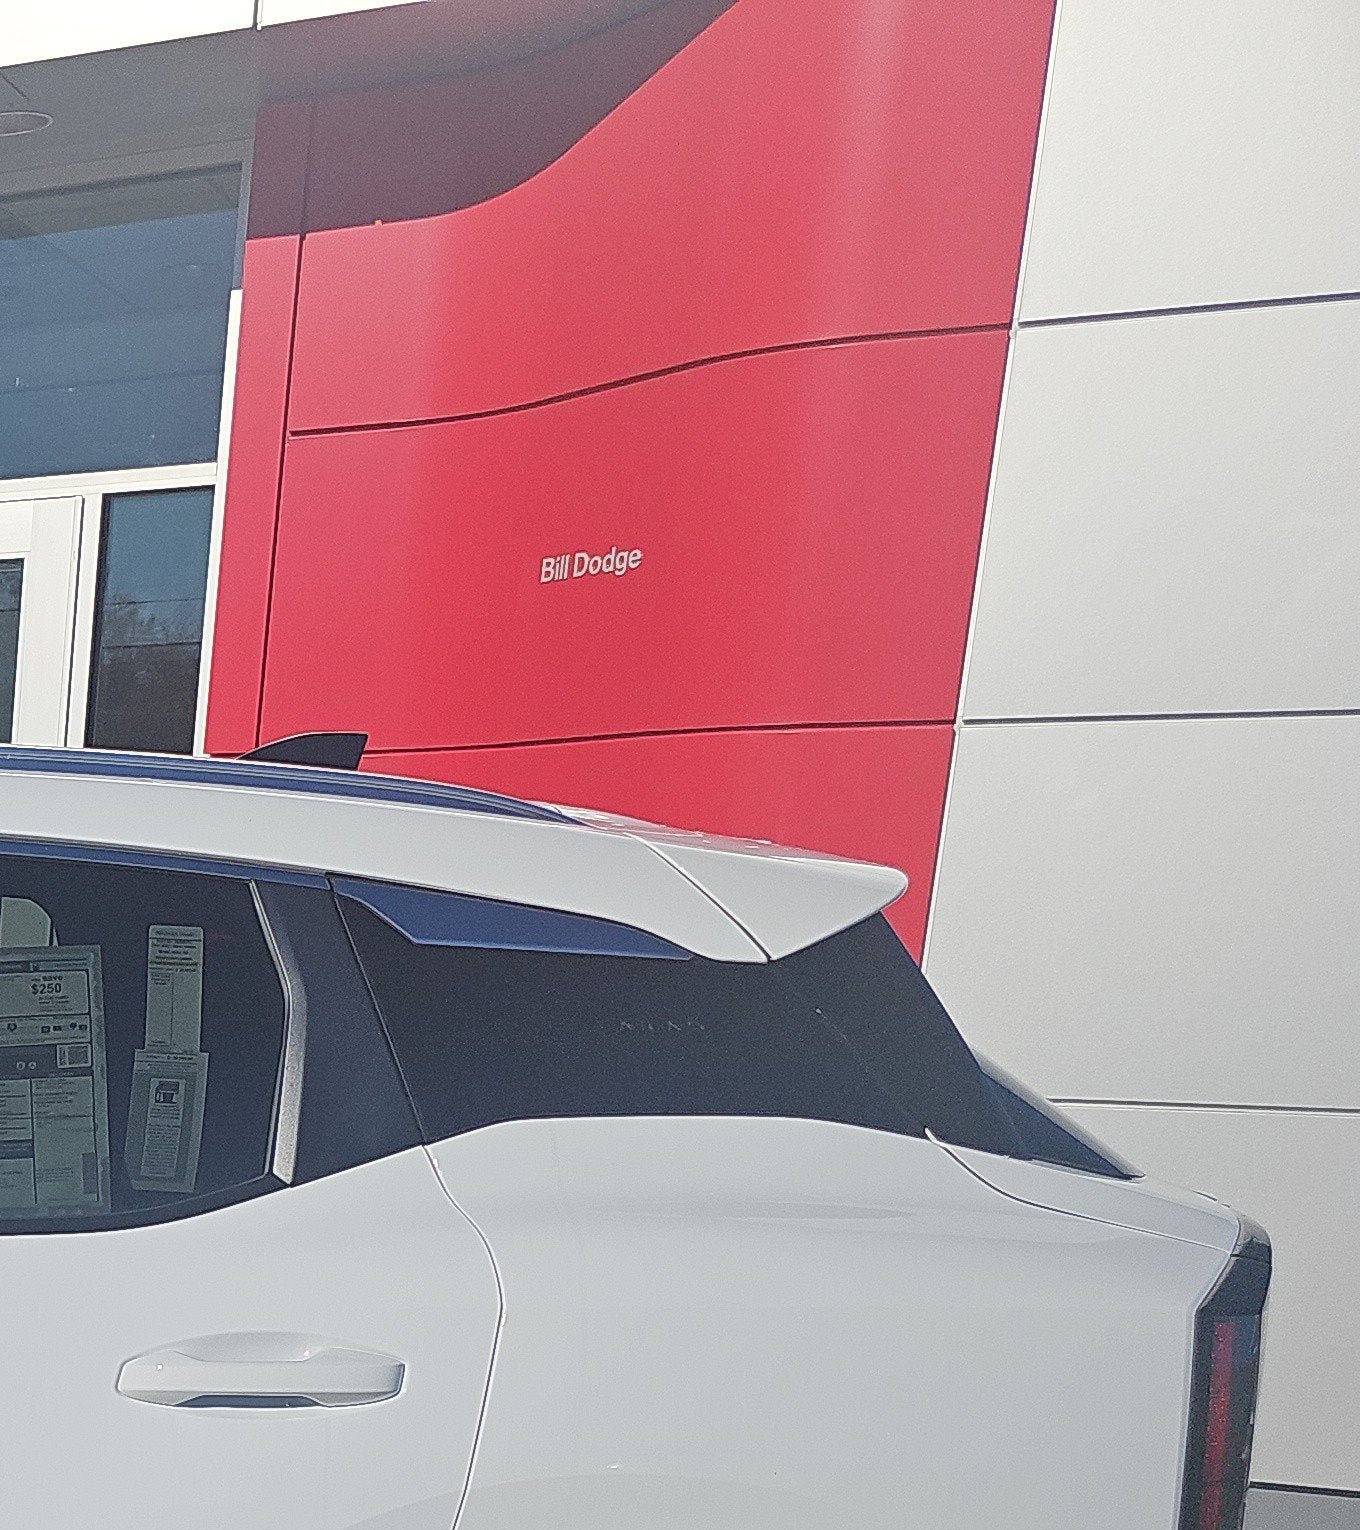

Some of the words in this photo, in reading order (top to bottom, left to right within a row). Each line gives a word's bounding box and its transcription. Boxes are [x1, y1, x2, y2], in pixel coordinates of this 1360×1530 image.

[540, 554, 570, 583] Bill
[573, 546, 643, 577] Dodge
[31, 983, 62, 995] $250
